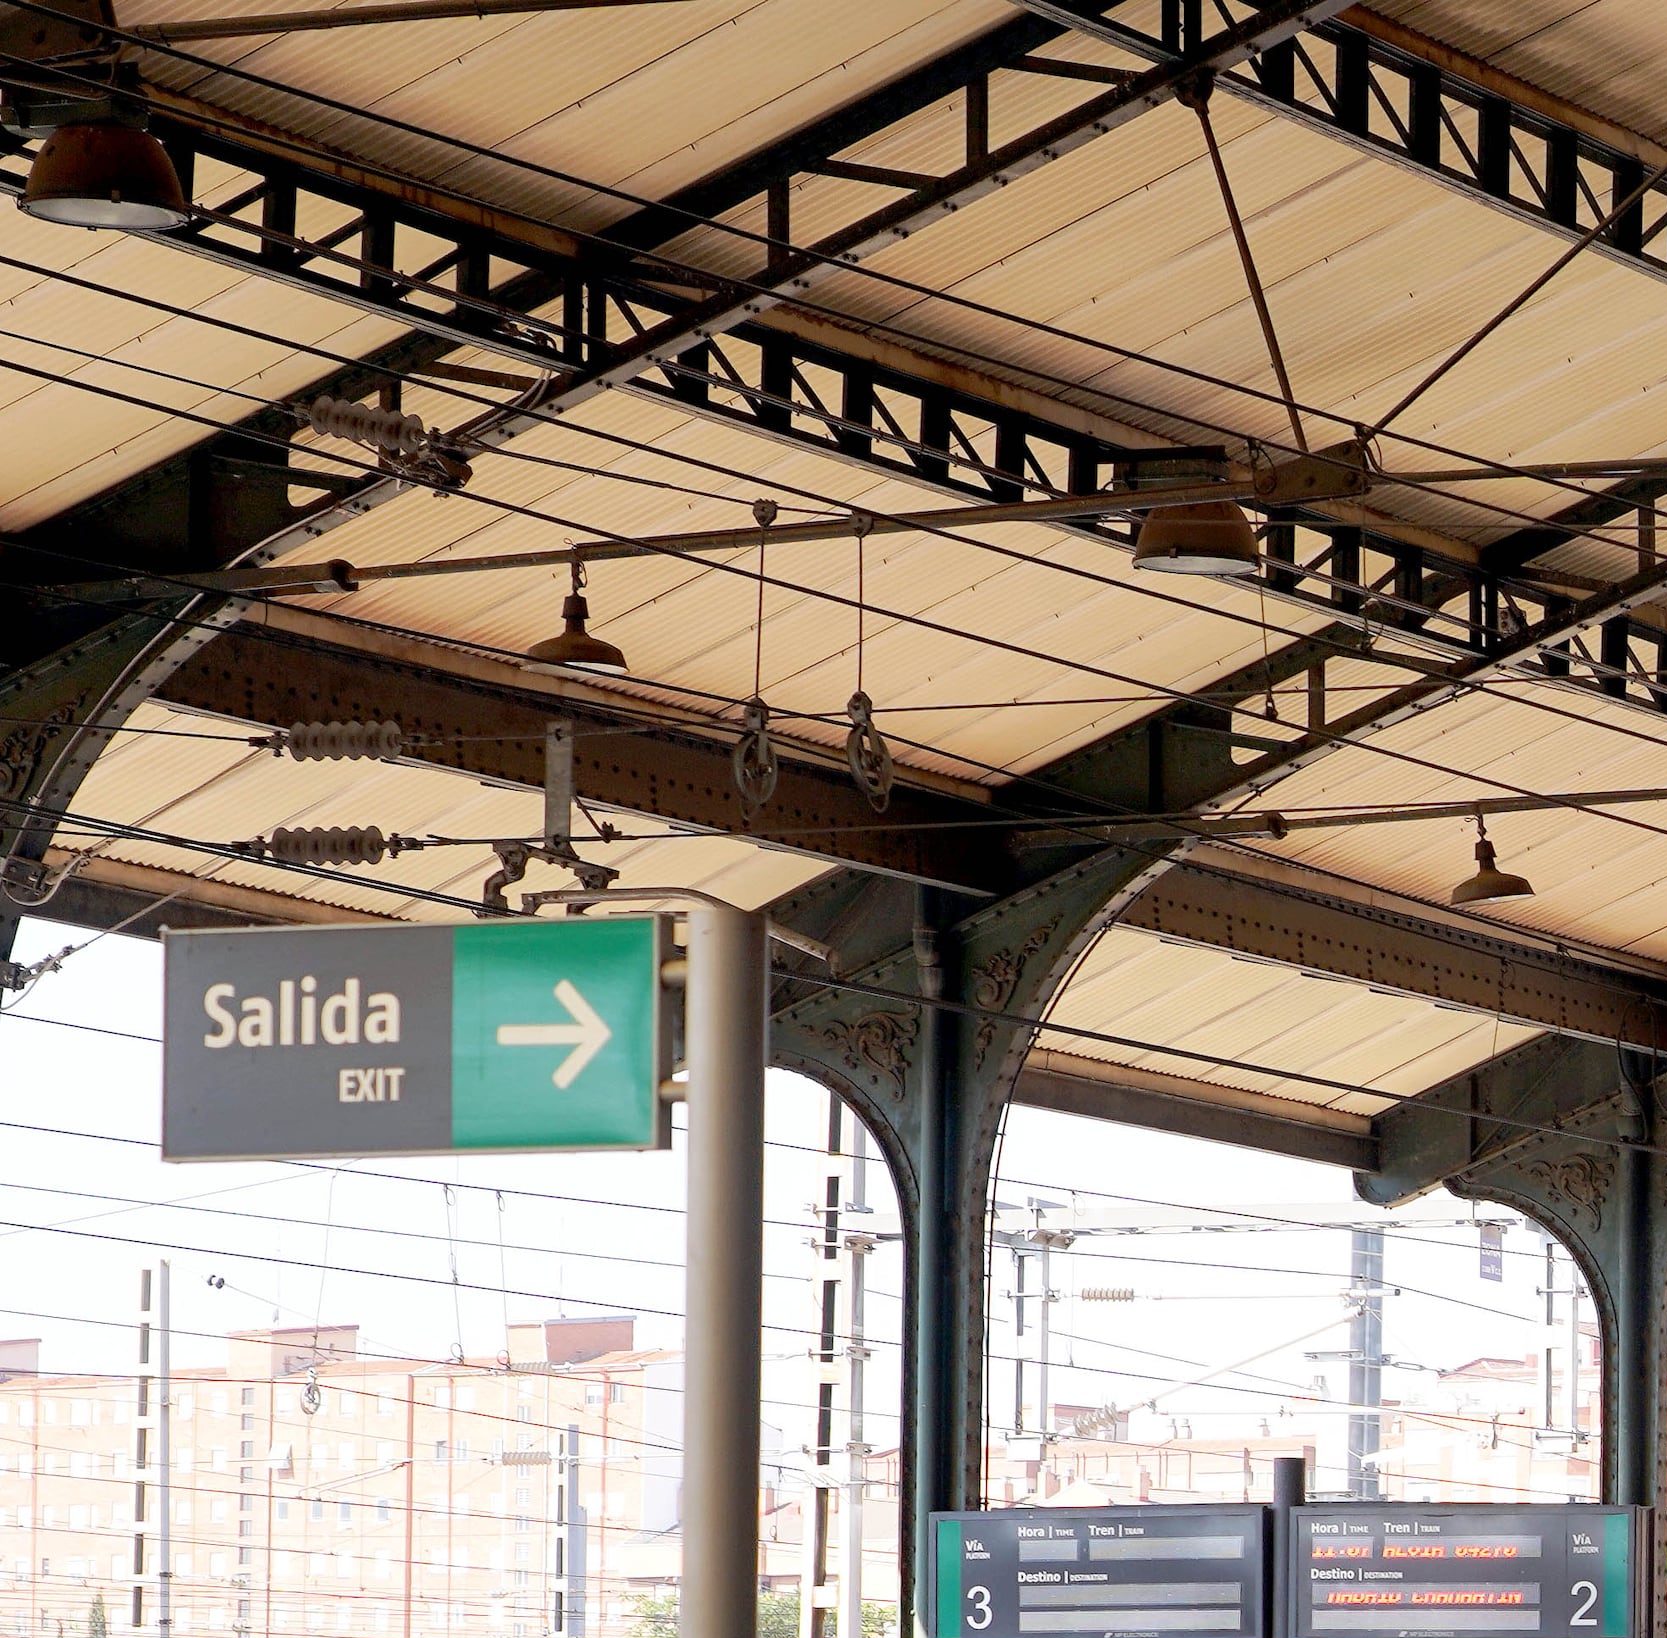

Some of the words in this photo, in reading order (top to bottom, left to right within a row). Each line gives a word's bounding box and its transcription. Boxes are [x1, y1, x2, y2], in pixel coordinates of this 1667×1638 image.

[203, 975, 401, 1049] Salida
[339, 1067, 406, 1103] EXIT
[1018, 1526, 1045, 1537] Hora
[1055, 1528, 1074, 1537] TIME
[1088, 1525, 1115, 1536] Tren
[1311, 1523, 1339, 1534] Hora
[1349, 1525, 1369, 1533] TIME
[1383, 1522, 1410, 1533] Tren
[1420, 1524, 1441, 1533] TRAIN
[1018, 1571, 1061, 1582] Destino
[1310, 1567, 1354, 1579] Destino
[966, 1585, 993, 1630] 3
[1569, 1580, 1598, 1626] 2
